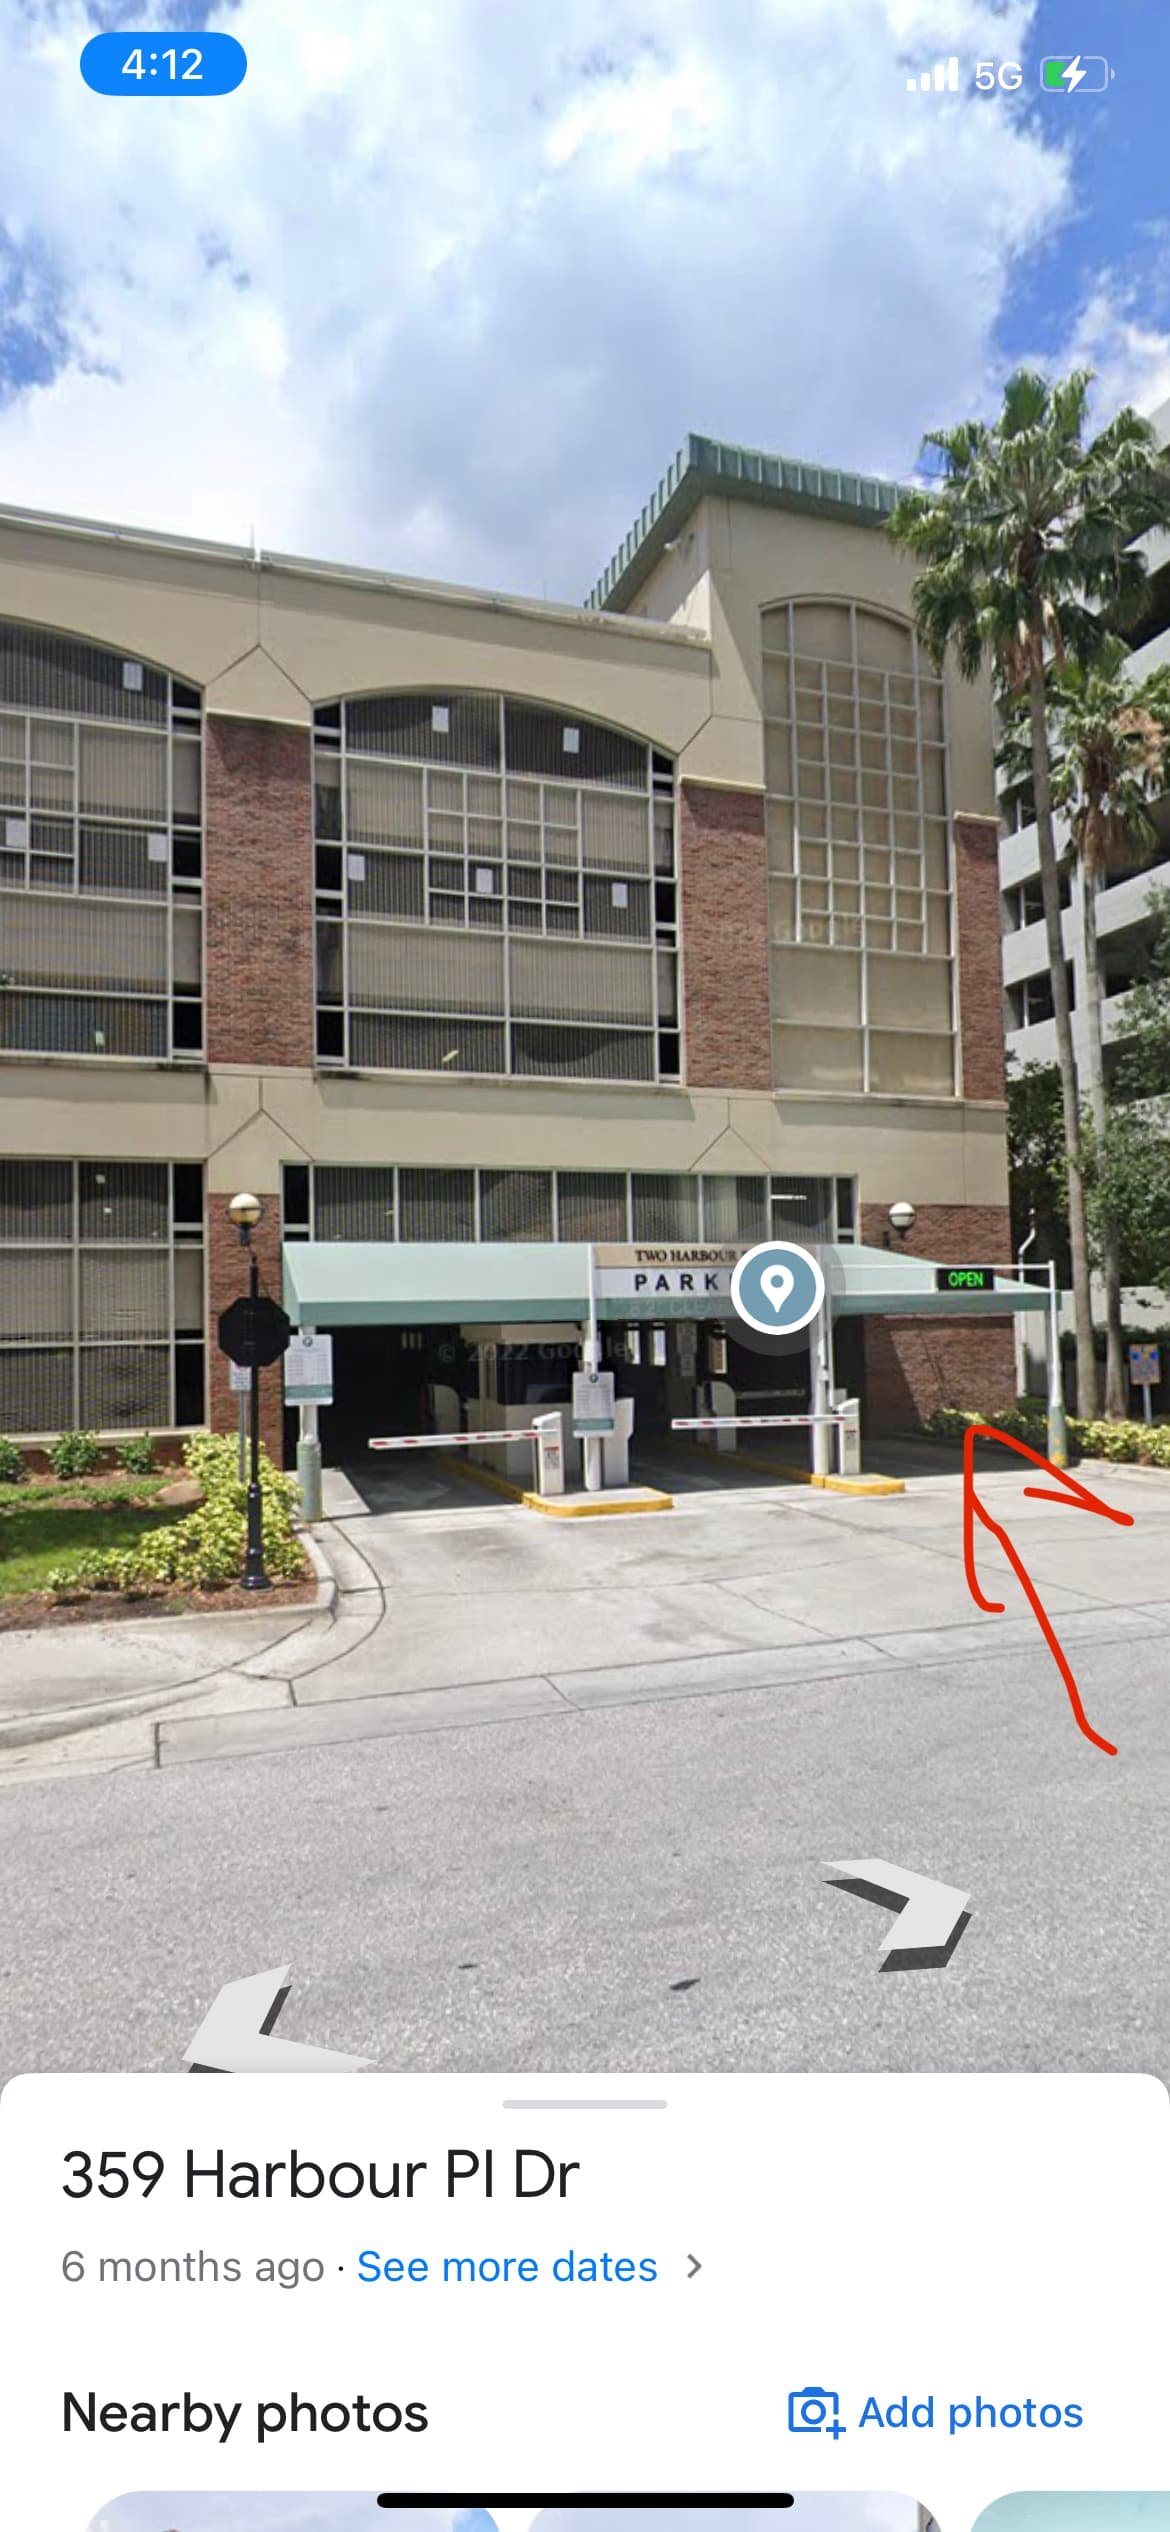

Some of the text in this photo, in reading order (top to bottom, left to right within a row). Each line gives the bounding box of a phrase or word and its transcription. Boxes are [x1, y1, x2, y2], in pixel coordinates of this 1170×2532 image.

[634, 1249, 667, 1262] TWO
[670, 1249, 739, 1262] HARBOUR
[634, 1273, 732, 1292] PARK
[947, 1270, 984, 1288] OPEN
